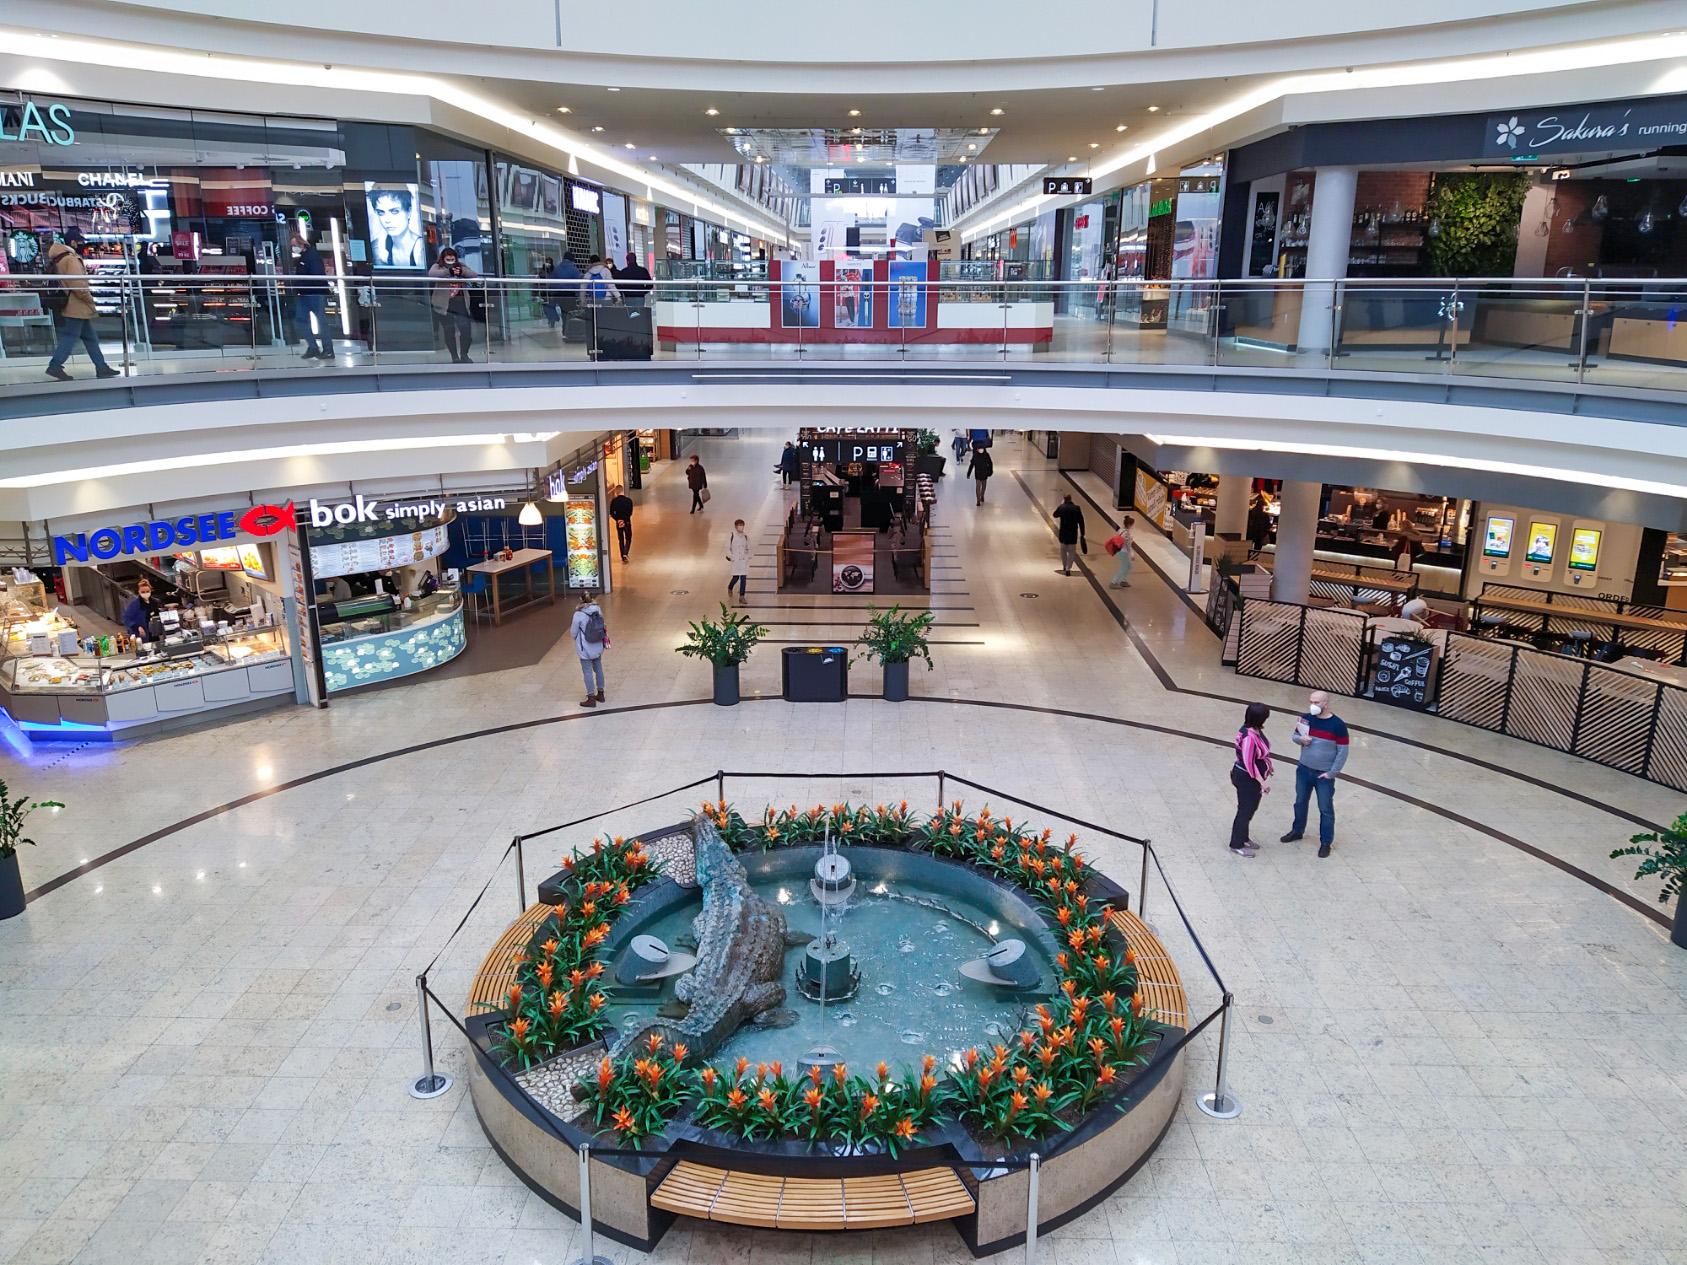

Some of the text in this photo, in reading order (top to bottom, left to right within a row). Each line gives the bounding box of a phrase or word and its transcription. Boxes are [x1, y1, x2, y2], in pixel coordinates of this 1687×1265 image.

[1528, 108, 1687, 148] Sakura's running
[77, 171, 146, 188] CHANEL
[1048, 182, 1056, 194] P
[853, 446, 863, 461] P
[310, 494, 506, 528] bok simply asian
[53, 511, 236, 566] NORDSEE
